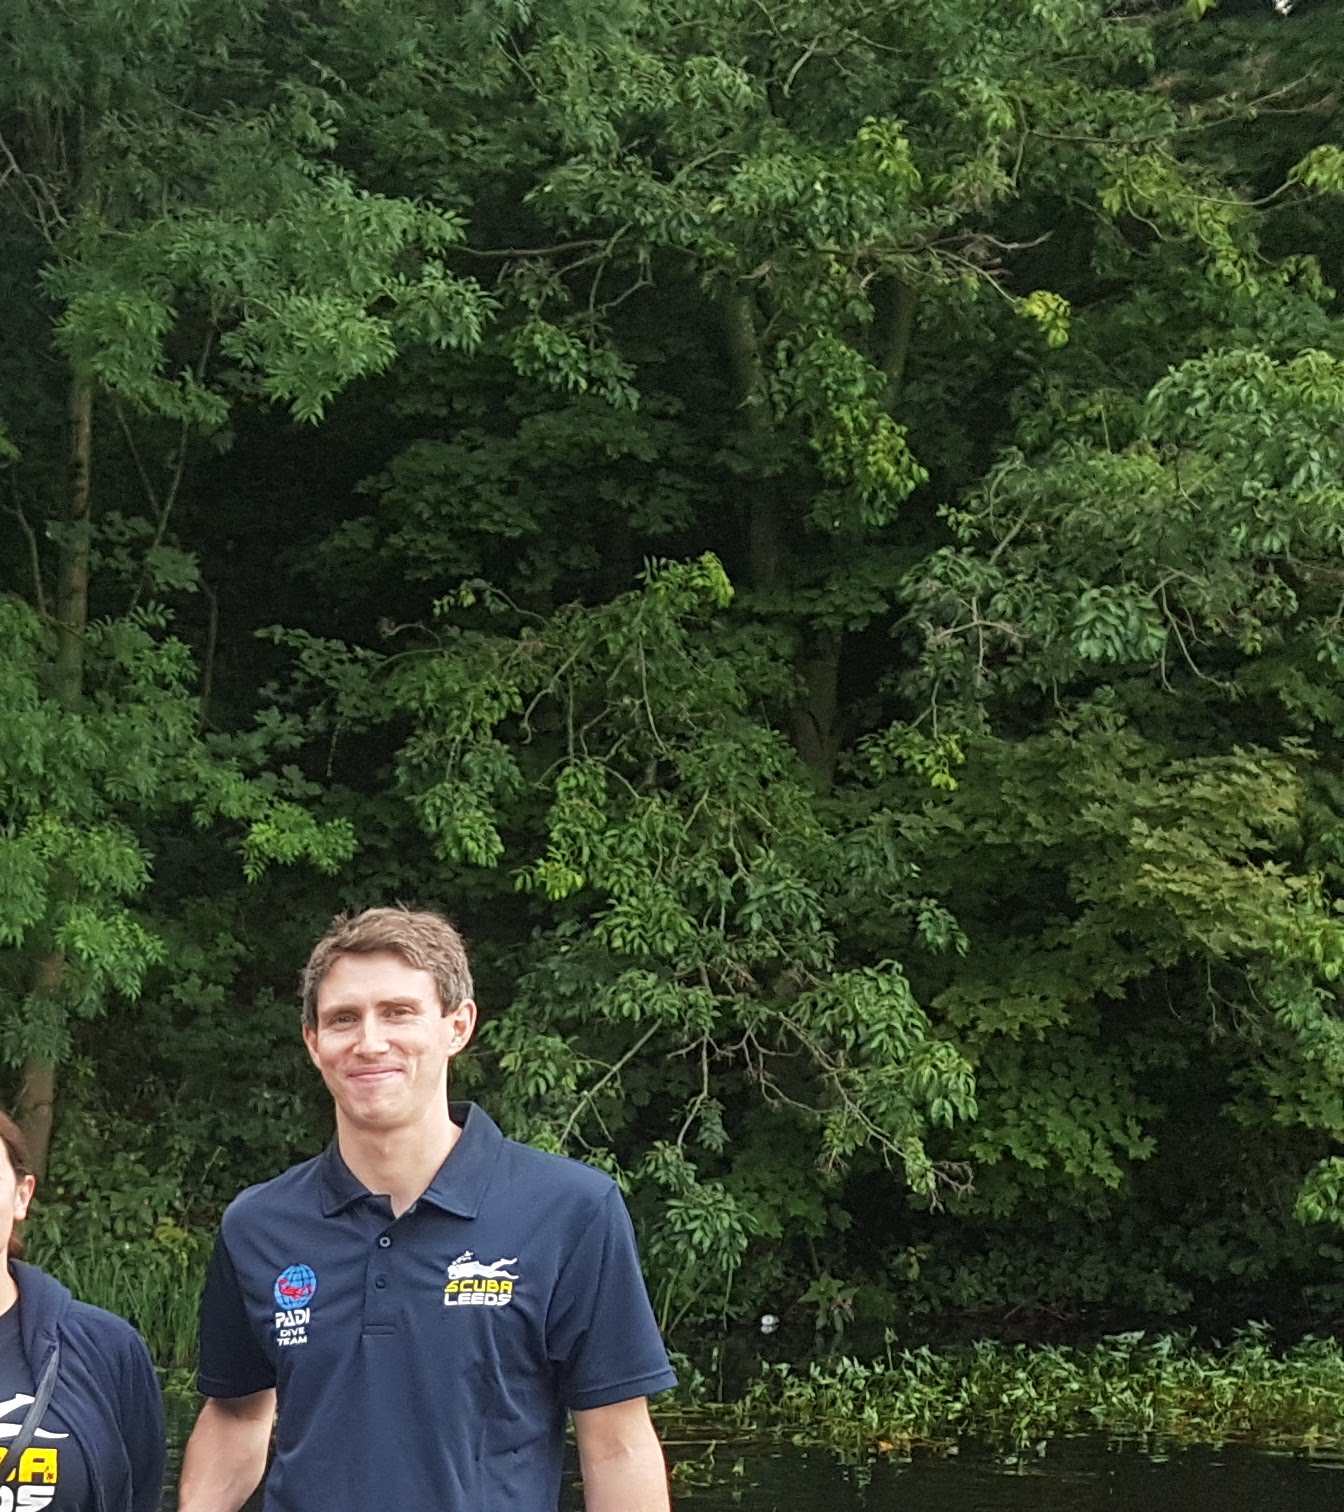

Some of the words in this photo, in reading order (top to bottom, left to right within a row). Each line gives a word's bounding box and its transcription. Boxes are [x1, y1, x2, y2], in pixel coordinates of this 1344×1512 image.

[444, 1279, 513, 1293] SCUBA
[444, 1293, 512, 1306] LEEDS
[275, 1308, 311, 1328] PADI
[280, 1326, 305, 1338] DIVE
[276, 1336, 307, 1346] TEAM
